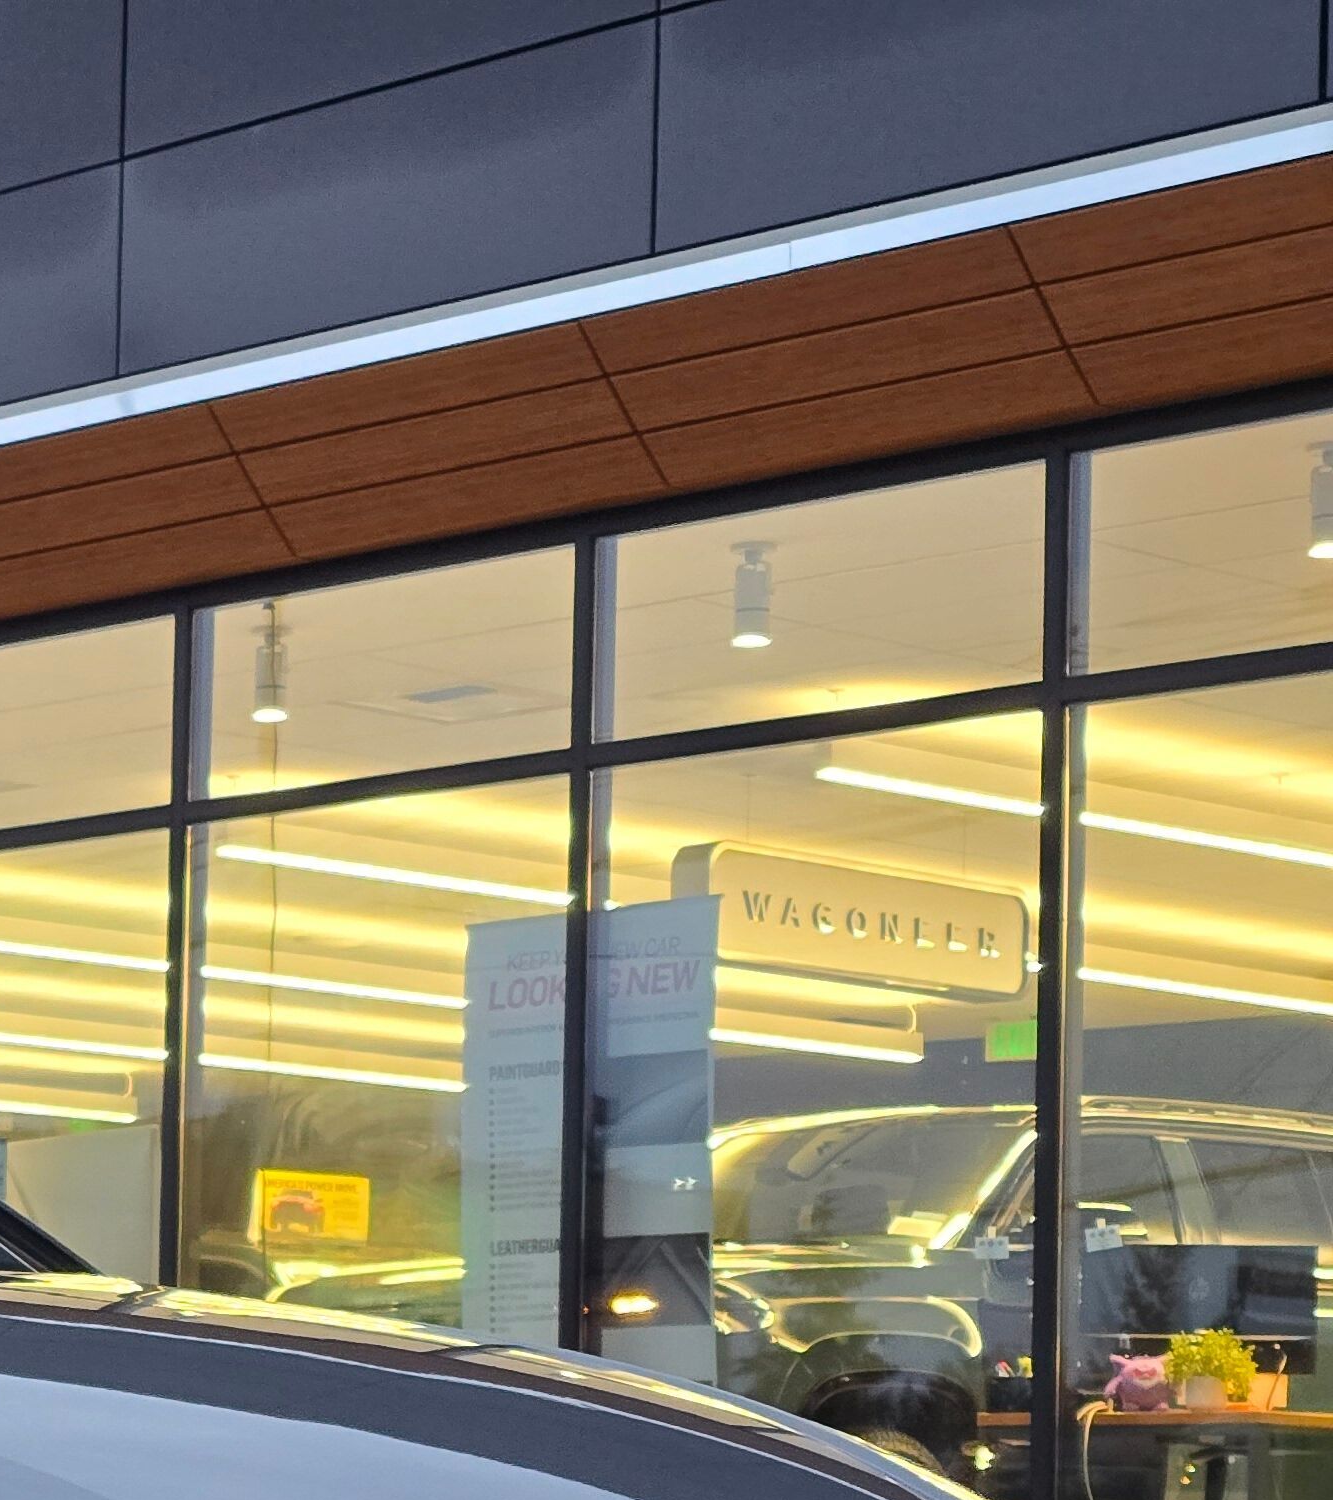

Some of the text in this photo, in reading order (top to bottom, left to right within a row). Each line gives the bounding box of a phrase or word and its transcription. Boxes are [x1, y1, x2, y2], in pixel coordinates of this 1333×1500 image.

[741, 889, 1001, 958] WAGONEER
[506, 949, 550, 972] KEEP
[626, 959, 701, 997] NEW
